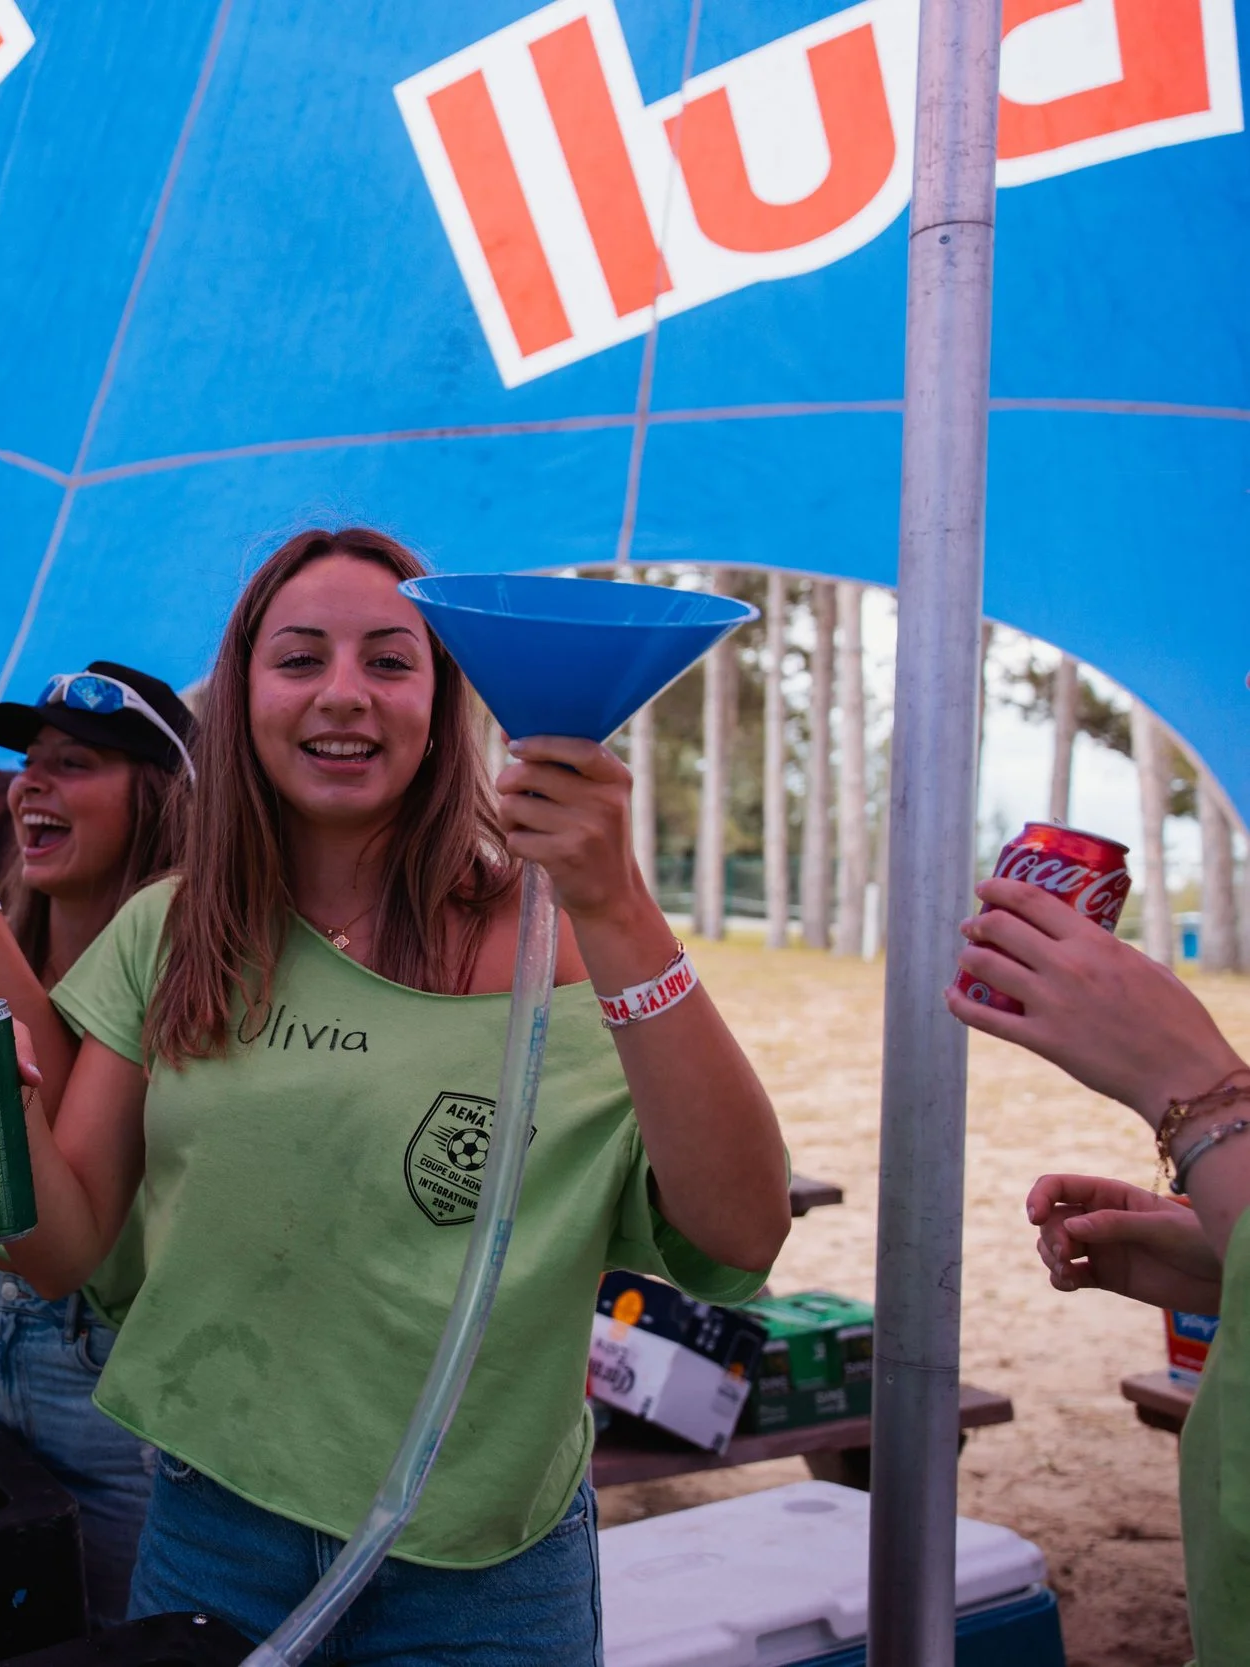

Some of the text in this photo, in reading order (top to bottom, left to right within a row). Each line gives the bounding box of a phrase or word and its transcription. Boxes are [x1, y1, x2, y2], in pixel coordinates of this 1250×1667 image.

[237, 1000, 367, 1053] Olivia
[445, 1103, 487, 1128] AEMA
[420, 1157, 449, 1176] COUPE
[449, 1170, 462, 1183] DU
[418, 1177, 479, 1210] INTÉGRATIONS
